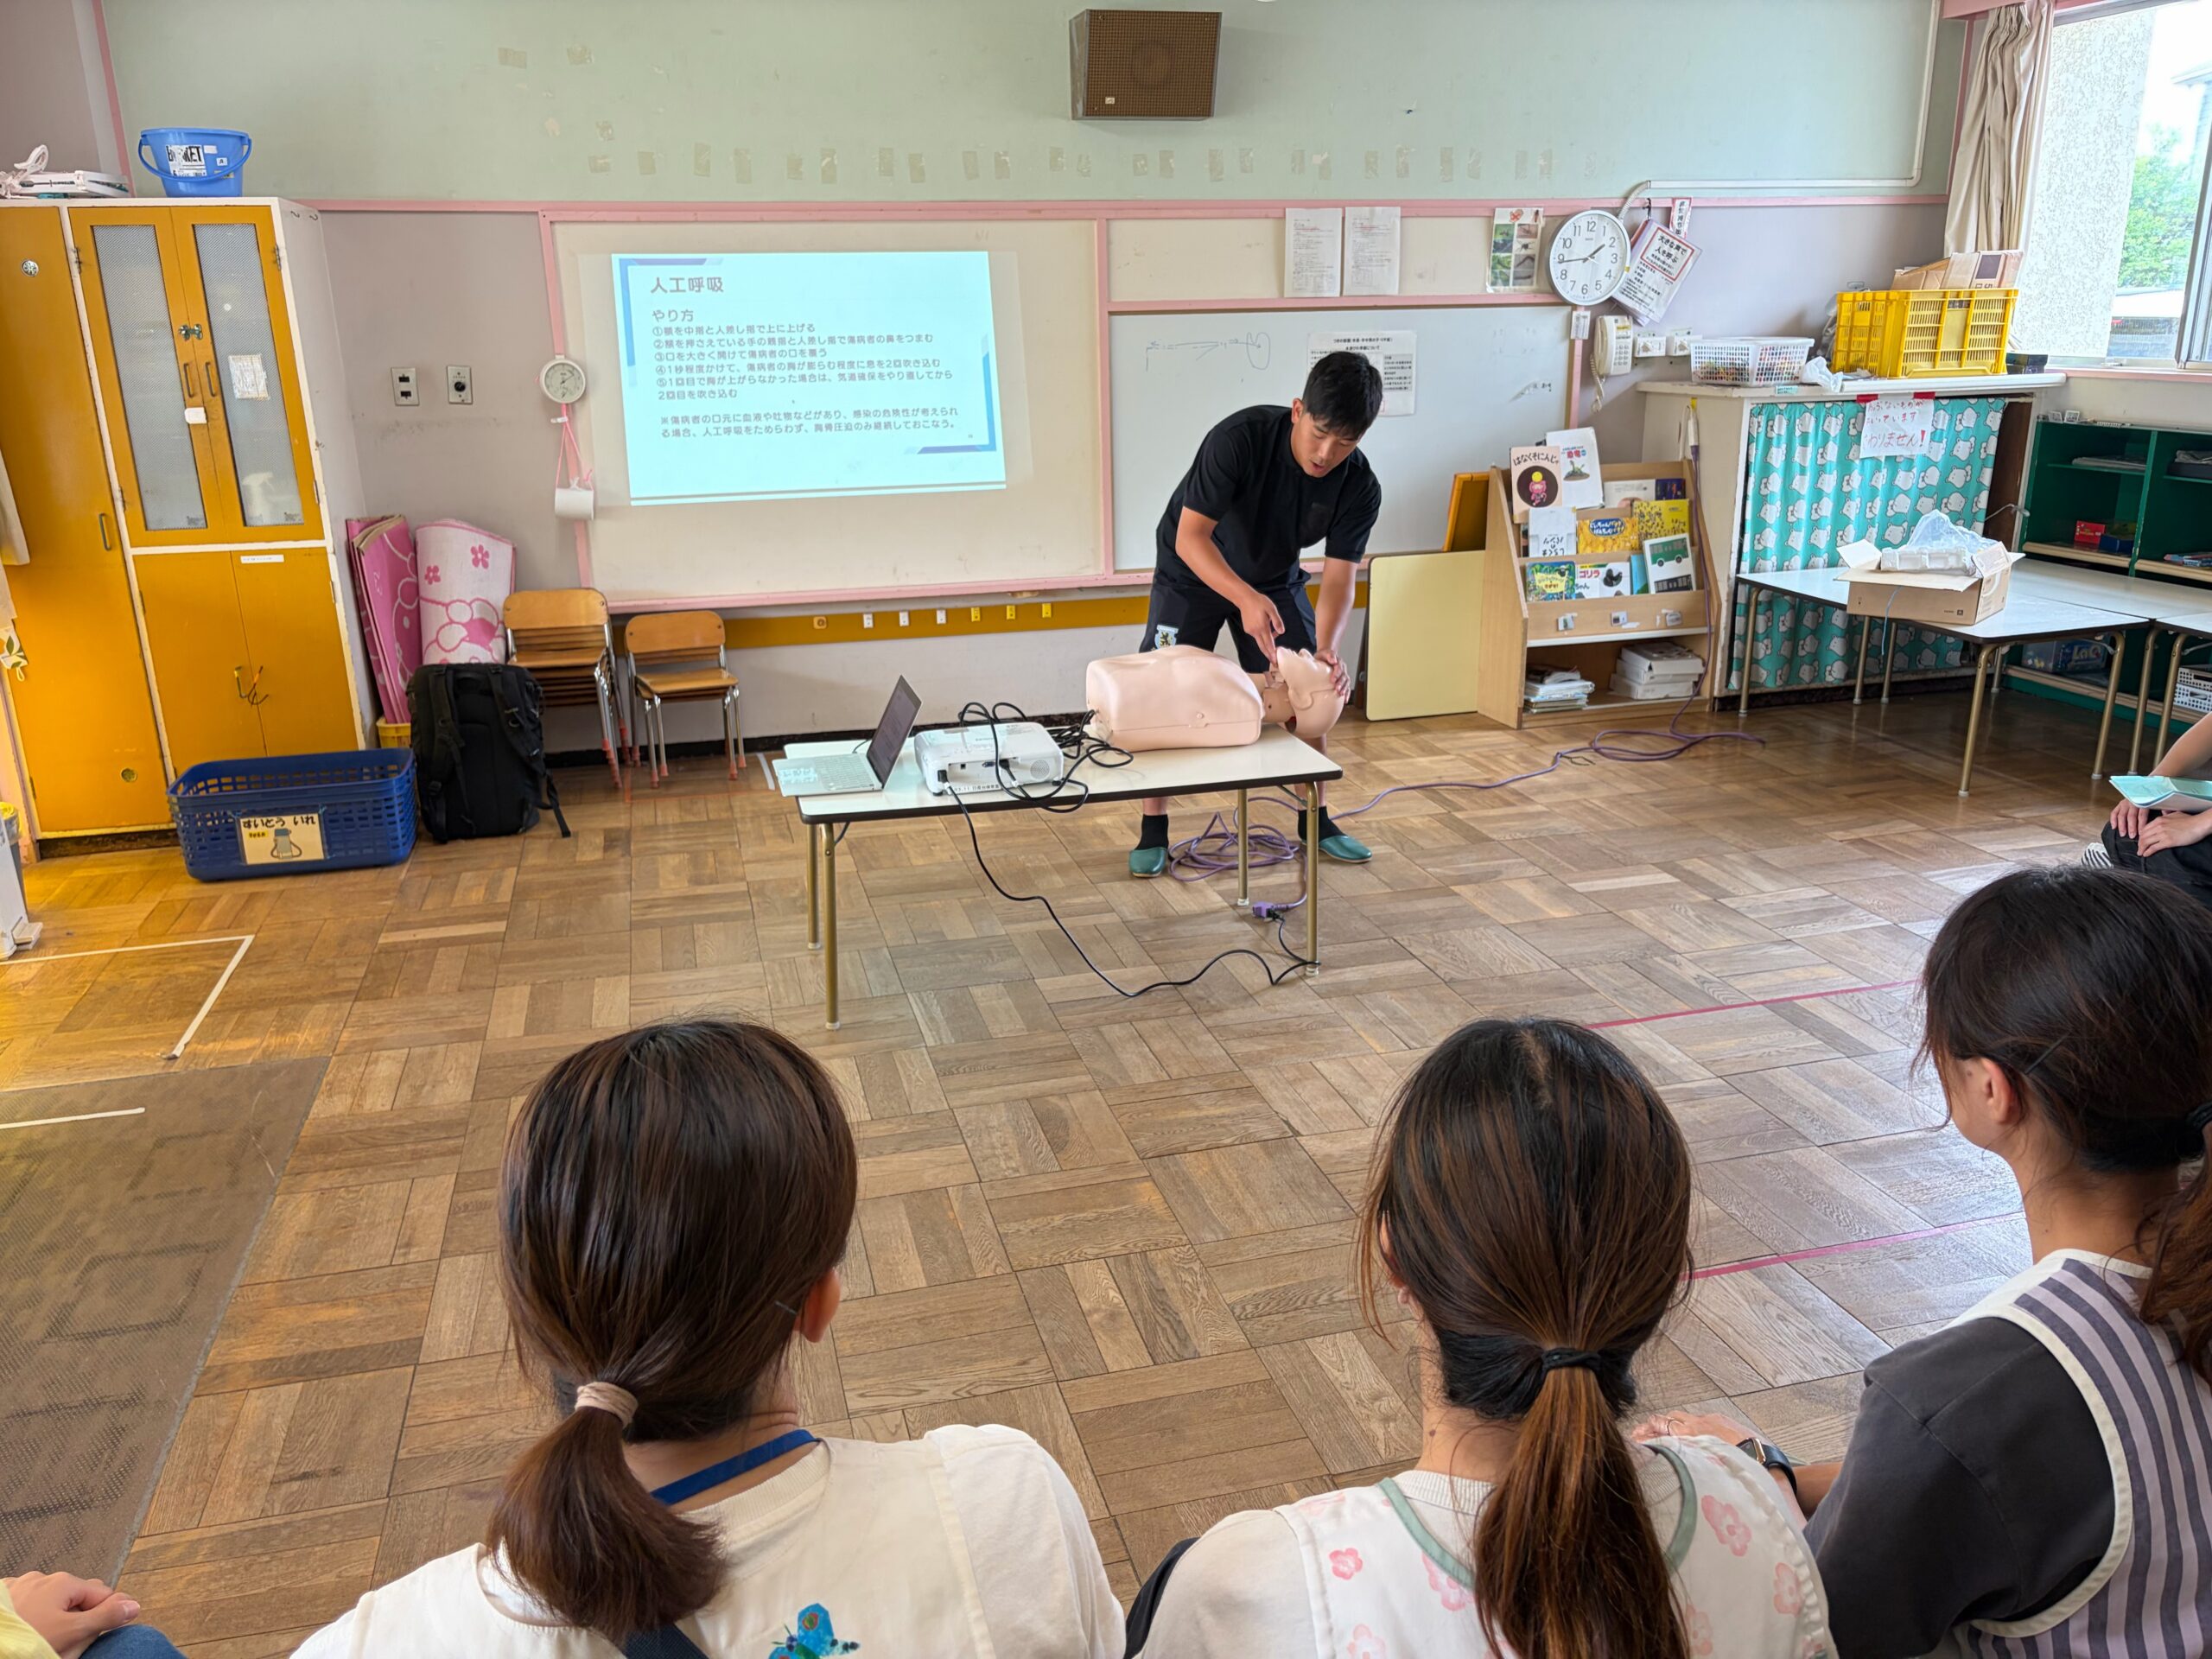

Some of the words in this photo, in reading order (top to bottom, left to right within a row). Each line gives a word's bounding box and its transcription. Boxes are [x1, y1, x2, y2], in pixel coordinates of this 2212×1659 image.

[1573, 225, 1581, 237] 11
[1587, 220, 1597, 232] 12
[1603, 226, 1606, 237] 1
[1562, 238, 1573, 249] 10
[1609, 237, 1617, 248] 2
[1658, 235, 1688, 255] 大きな声で
[1557, 253, 1565, 264] 9
[1611, 253, 1618, 264] 3
[1654, 246, 1679, 264] 人を呼ぶ
[1560, 269, 1567, 280] 8
[1605, 269, 1612, 279] 4
[650, 276, 725, 294] 人工呼吸
[1570, 280, 1576, 291] 7
[1581, 284, 1589, 295] 6
[1595, 280, 1602, 290] 5
[652, 308, 695, 323] やり方
[658, 388, 738, 400] 2回目を吹き込む
[1513, 451, 1559, 467] はなくそにんじゃ
[1580, 569, 1600, 579] ゴリラ
[242, 816, 286, 829] すいとう
[293, 816, 316, 826] いれ
